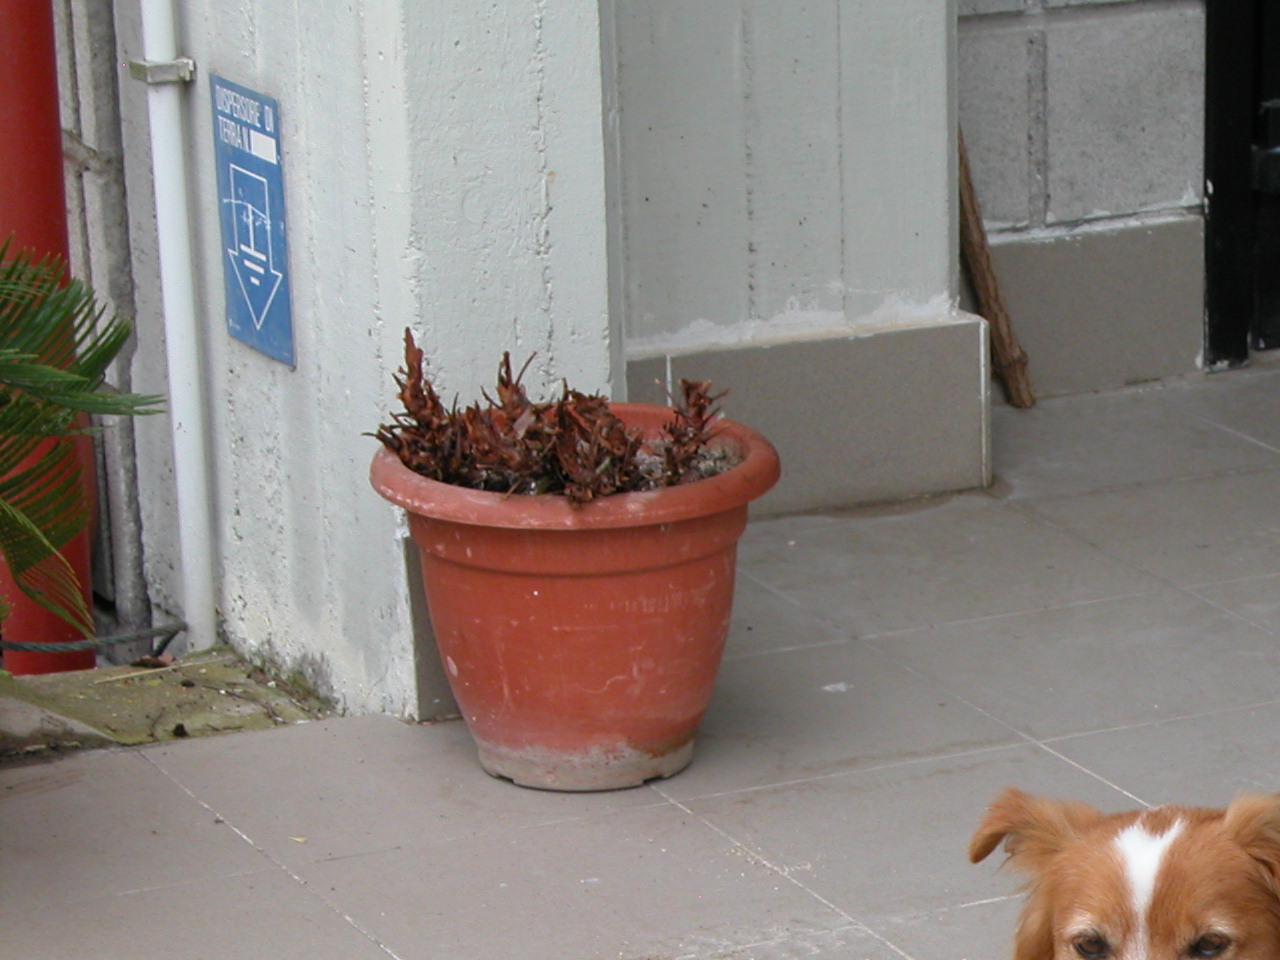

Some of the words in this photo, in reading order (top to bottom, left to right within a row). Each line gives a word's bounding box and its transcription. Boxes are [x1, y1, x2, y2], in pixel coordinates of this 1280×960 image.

[215, 84, 261, 128] DISPERSORE
[264, 104, 274, 133] DI
[217, 114, 243, 150] TERRA
